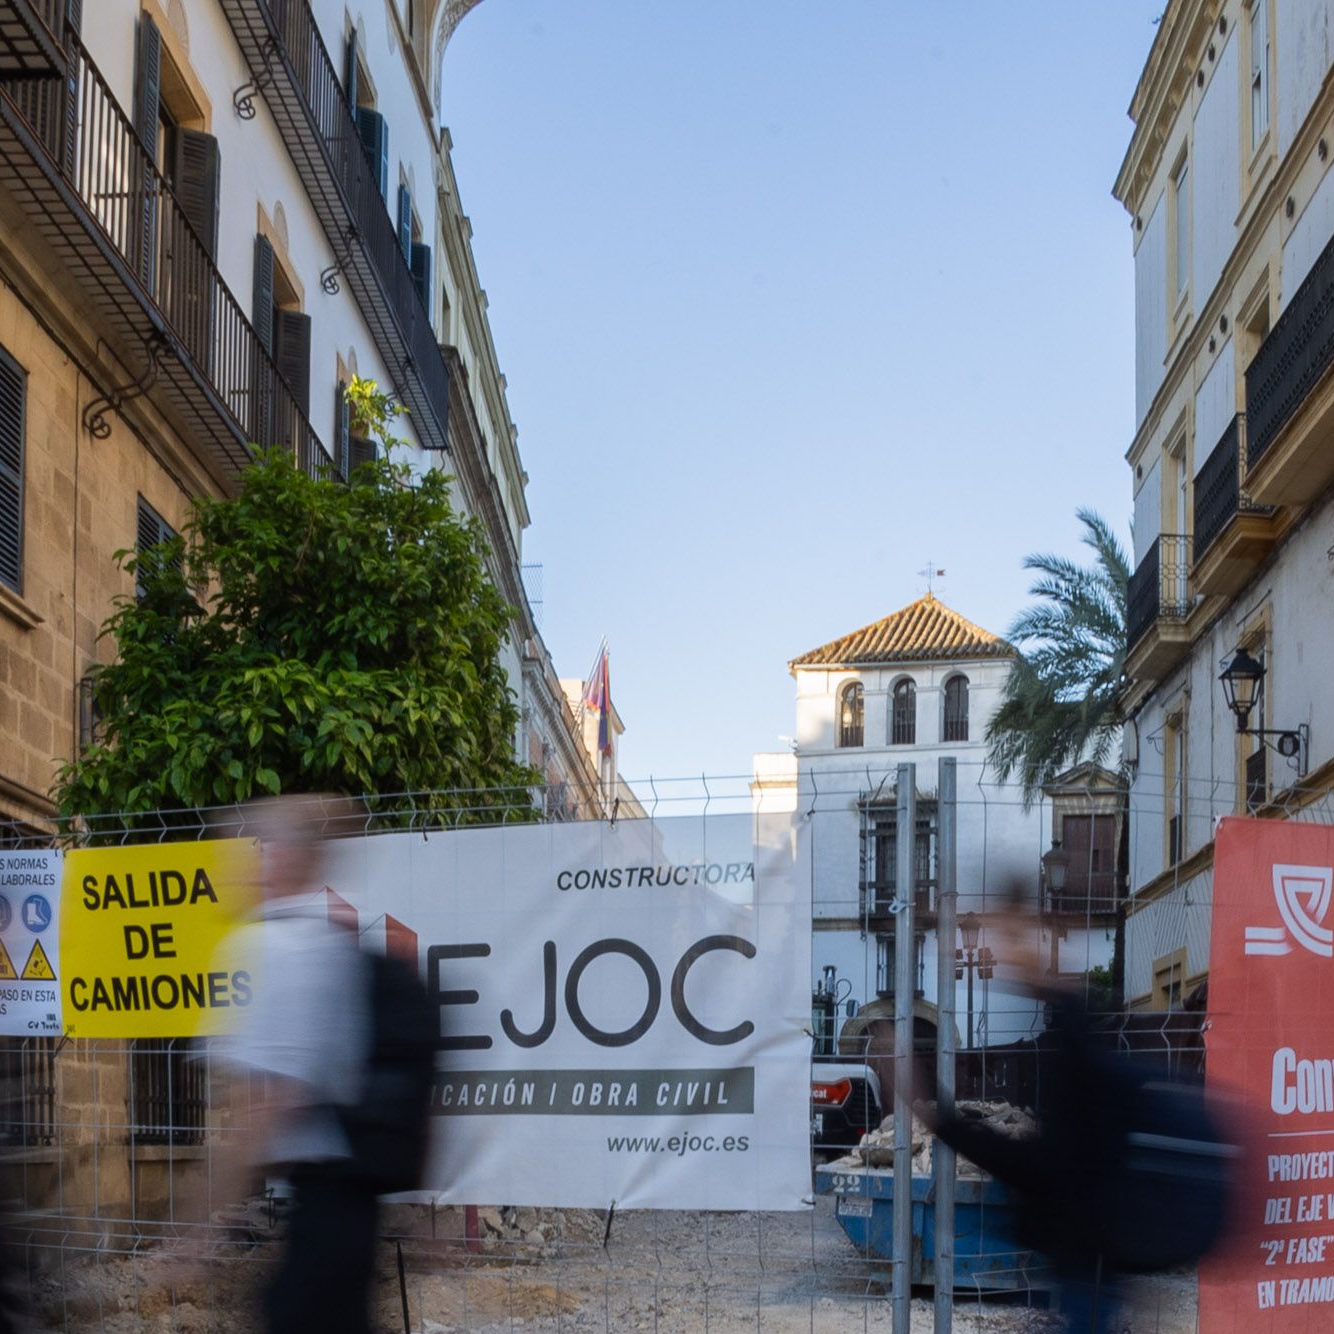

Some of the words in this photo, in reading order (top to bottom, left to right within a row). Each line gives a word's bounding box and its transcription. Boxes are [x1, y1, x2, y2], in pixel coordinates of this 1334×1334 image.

[7, 857, 48, 870] NORMAS
[557, 863, 755, 891] CONSTRUCTORA
[1, 873, 56, 886] LABORALES
[83, 868, 219, 911] SALIDA
[123, 923, 177, 960] DE
[21, 989, 33, 1001] EN
[34, 990, 56, 1002] ESTA
[70, 970, 253, 1012] CAMIONES
[428, 934, 756, 1051] EJOC
[571, 1081, 638, 1106] OBRA
[656, 1081, 729, 1106] CIVIL
[606, 1131, 749, 1157] www.ejoc.es
[832, 1175, 860, 1193] 22
[1264, 1198, 1292, 1224] DEL
[1296, 1194, 1323, 1222] EJE
[1257, 1281, 1275, 1309] EN
